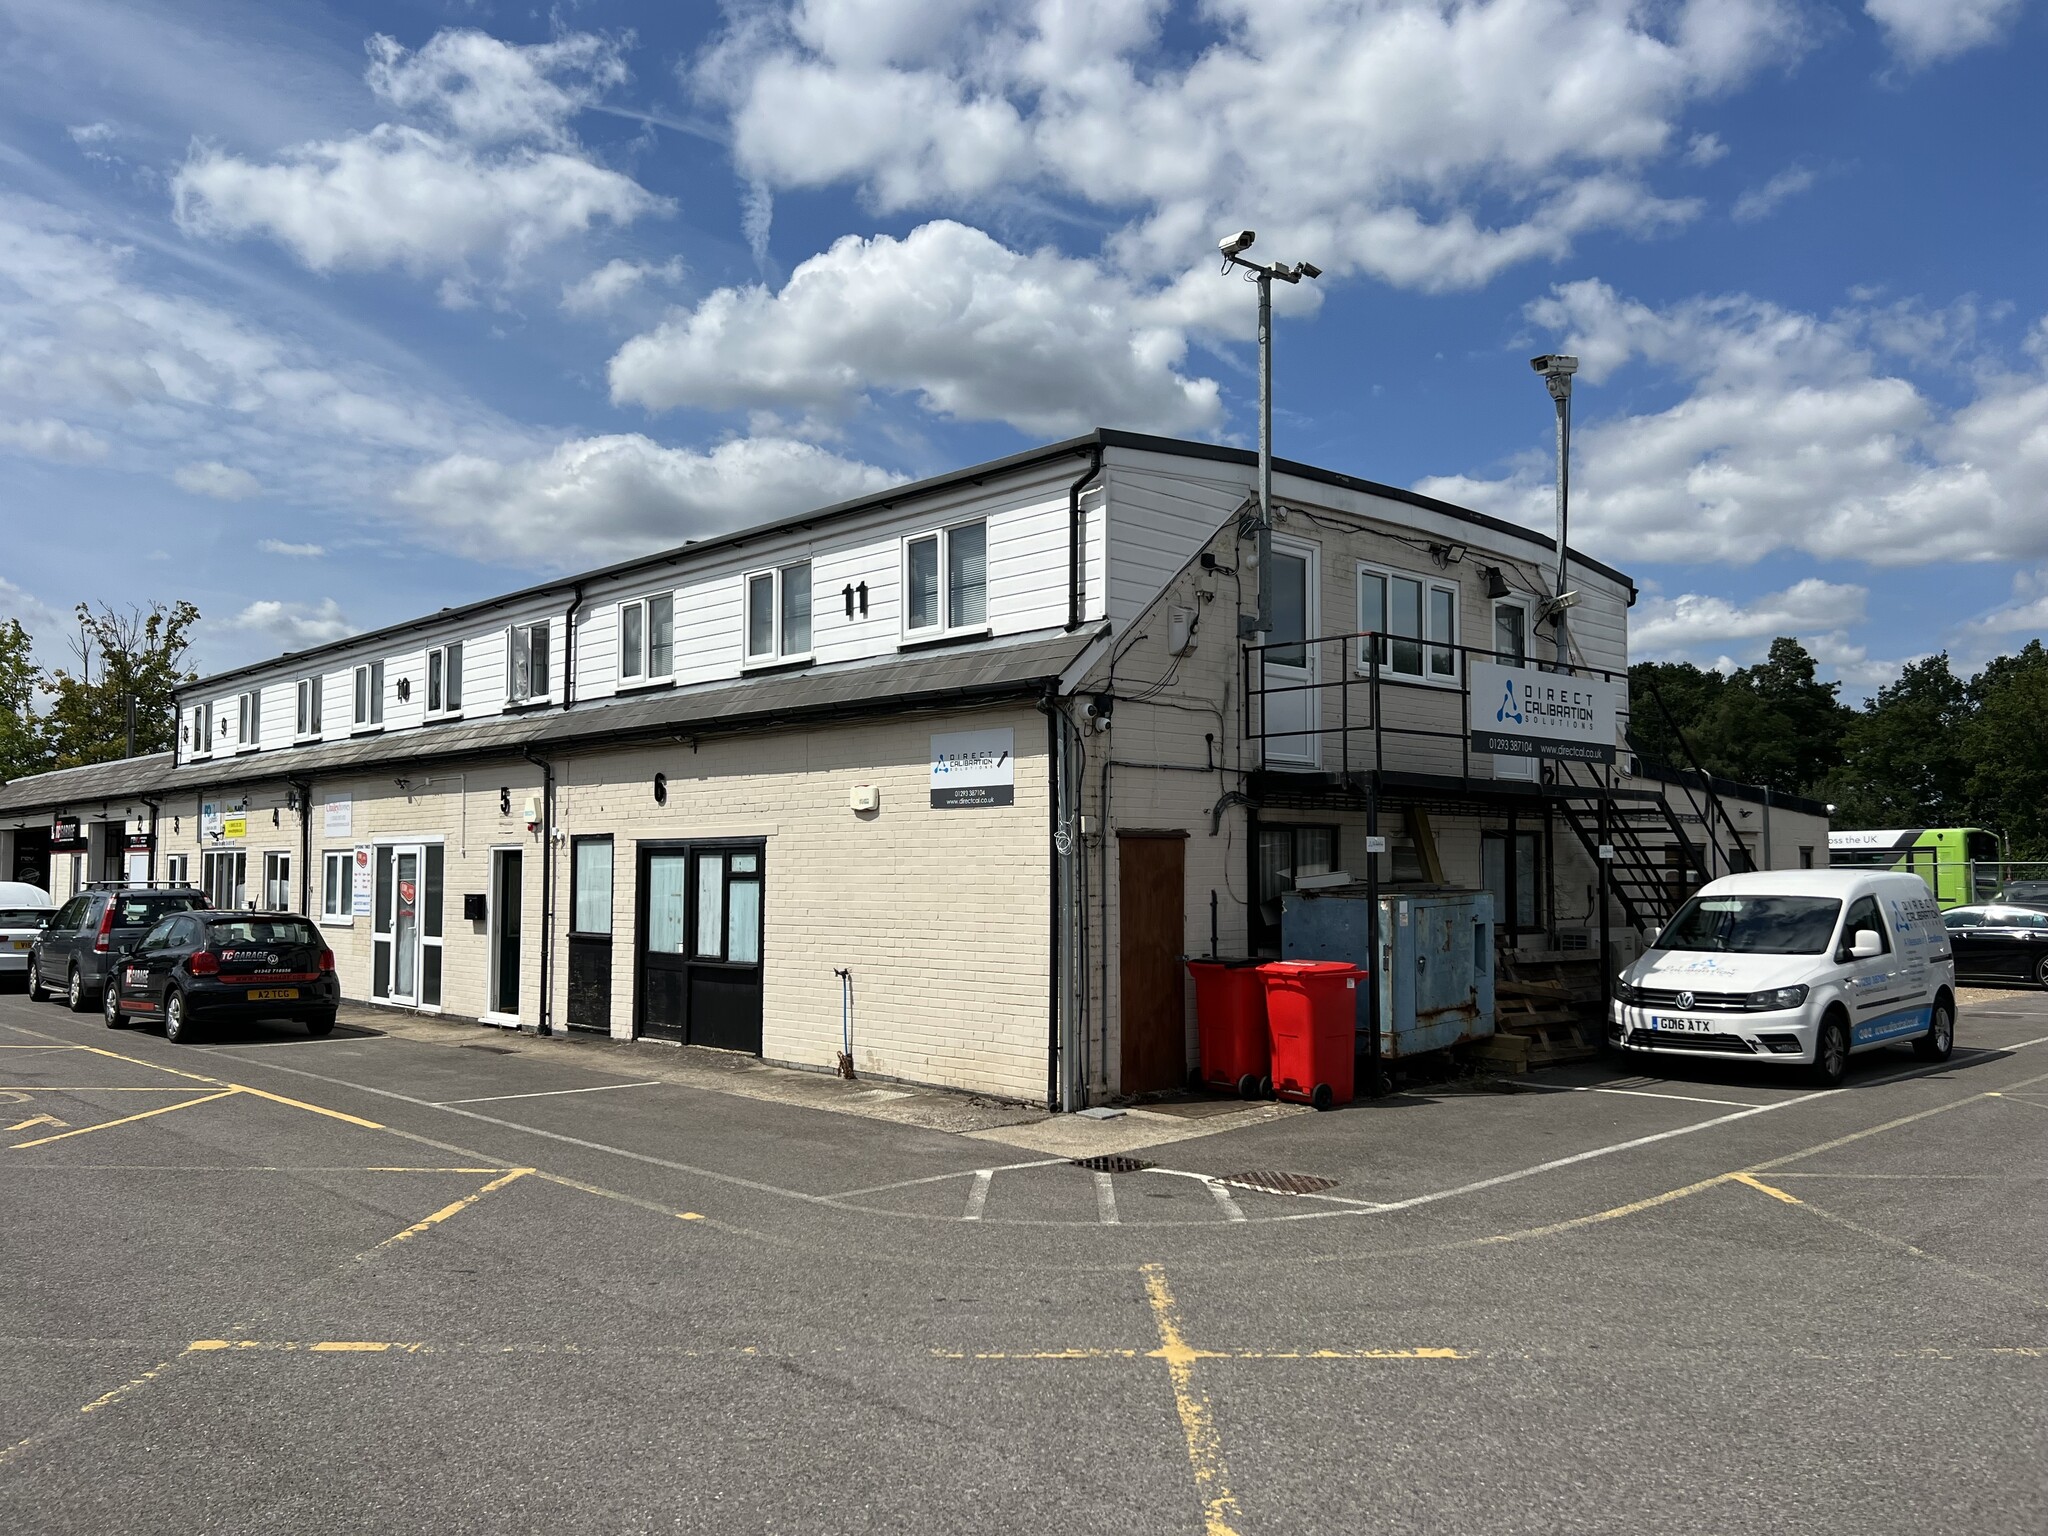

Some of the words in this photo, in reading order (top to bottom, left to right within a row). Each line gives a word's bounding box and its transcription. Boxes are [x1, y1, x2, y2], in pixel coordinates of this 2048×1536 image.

[842, 580, 868, 614] 11
[396, 677, 410, 700] 10
[1525, 685, 1593, 706] DIRECT
[1525, 701, 1593, 721] CALIBRATION
[1525, 715, 1593, 730] SOLUTIONS
[950, 751, 992, 760] DIRECT
[1489, 738, 1509, 751] 01293
[1510, 740, 1533, 753] 387104
[1540, 744, 1603, 759] www.directcal.co.uk
[950, 759, 992, 767] CALIBRATION
[654, 772, 667, 803] 6
[500, 786, 511, 813] 5
[1845, 836, 1861, 844] the
[1863, 835, 1878, 844] UK
[1901, 899, 1937, 911] DIRECT
[222, 951, 234, 961] TC
[233, 951, 268, 960] GARAGE
[258, 990, 270, 999] A2
[271, 989, 290, 998] TCG
[1660, 1018, 1685, 1031] GD16
[1688, 1020, 1710, 1033] ATX
